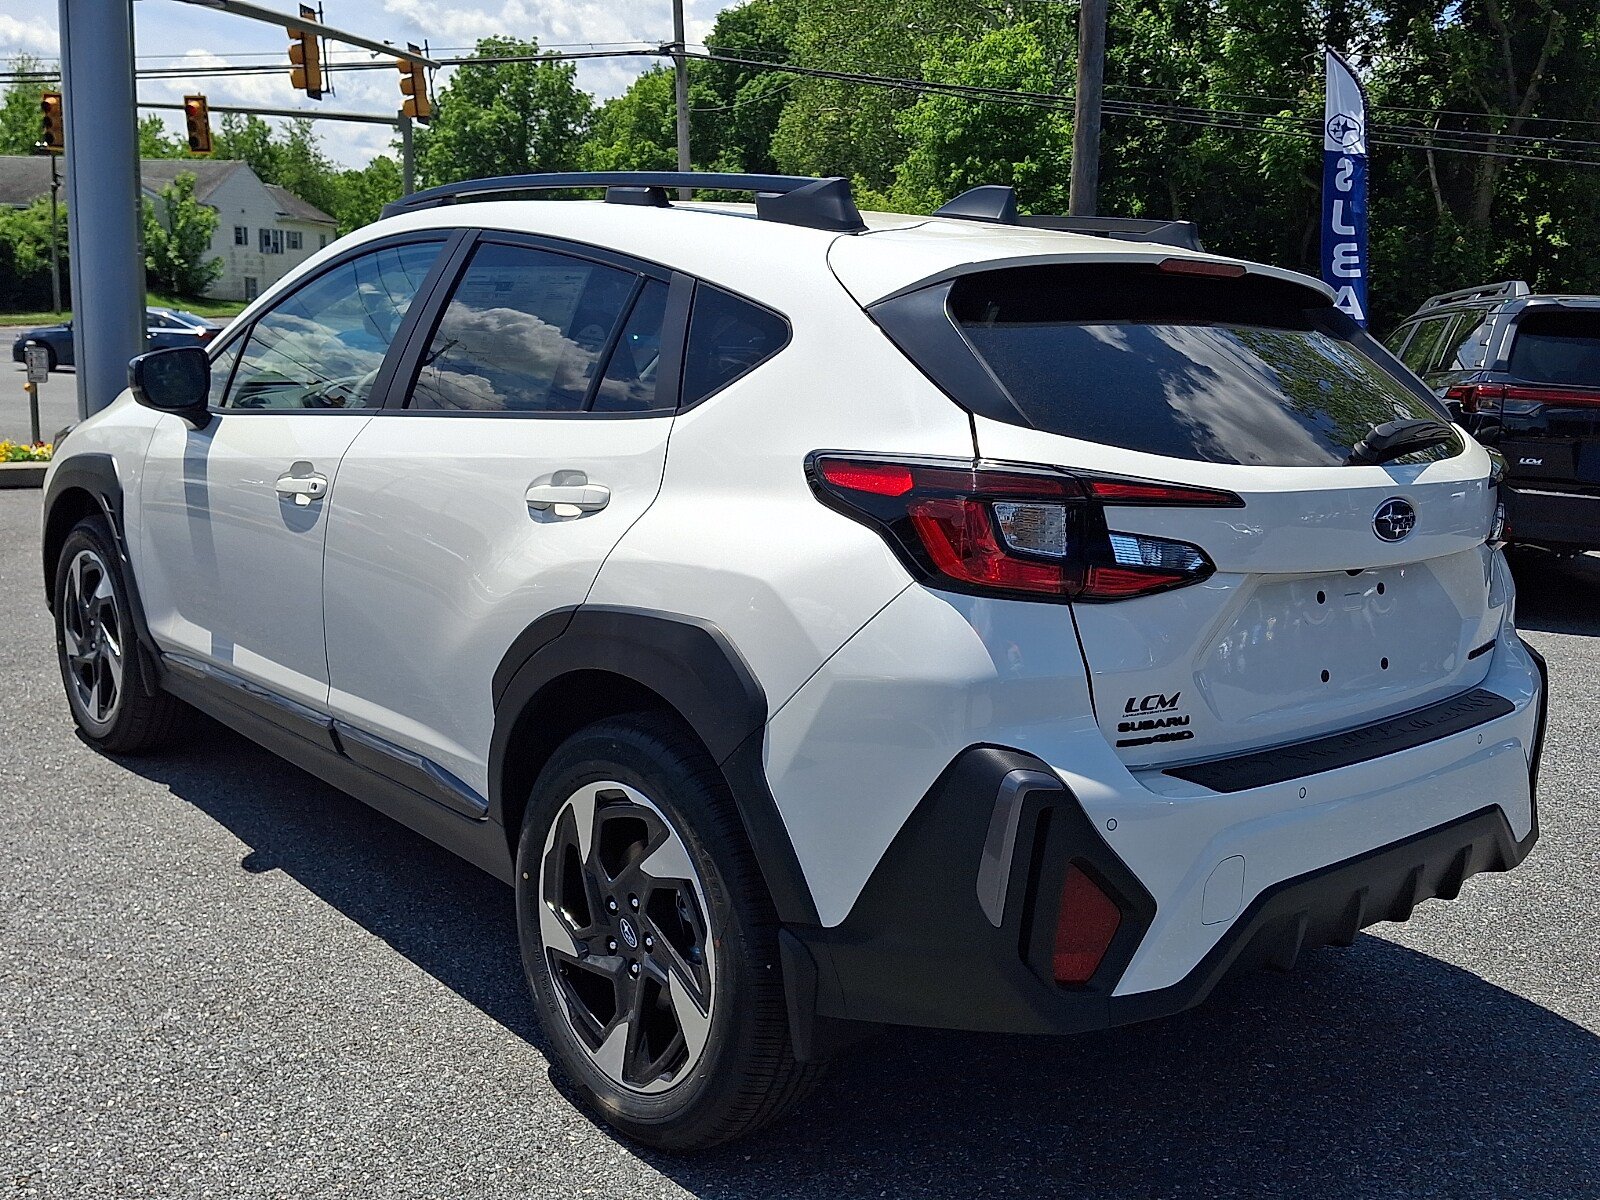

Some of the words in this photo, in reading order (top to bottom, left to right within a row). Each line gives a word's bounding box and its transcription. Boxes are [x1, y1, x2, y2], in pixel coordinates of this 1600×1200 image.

[1519, 457, 1543, 466] LCM
[1124, 691, 1181, 713] LCM
[1117, 714, 1190, 733] SUBARU
